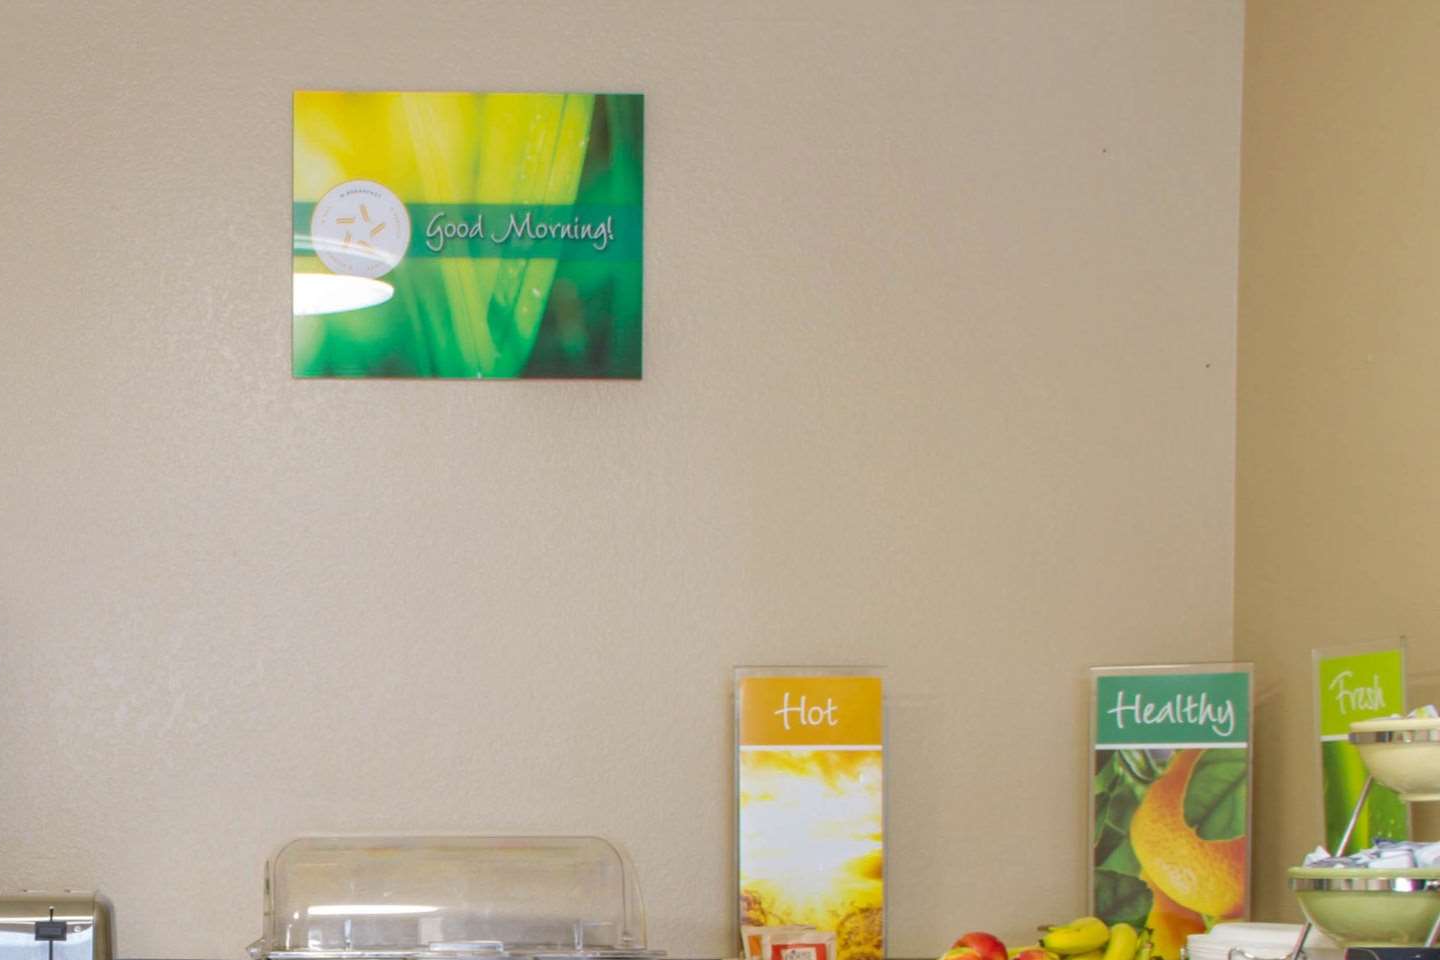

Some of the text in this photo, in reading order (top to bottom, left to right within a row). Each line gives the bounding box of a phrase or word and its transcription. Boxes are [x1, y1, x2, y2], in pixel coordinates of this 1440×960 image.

[426, 211, 615, 251] Good Morning!
[774, 691, 839, 731] Hot
[1106, 690, 1235, 737] Healthy
[1327, 670, 1387, 716] Fresh
